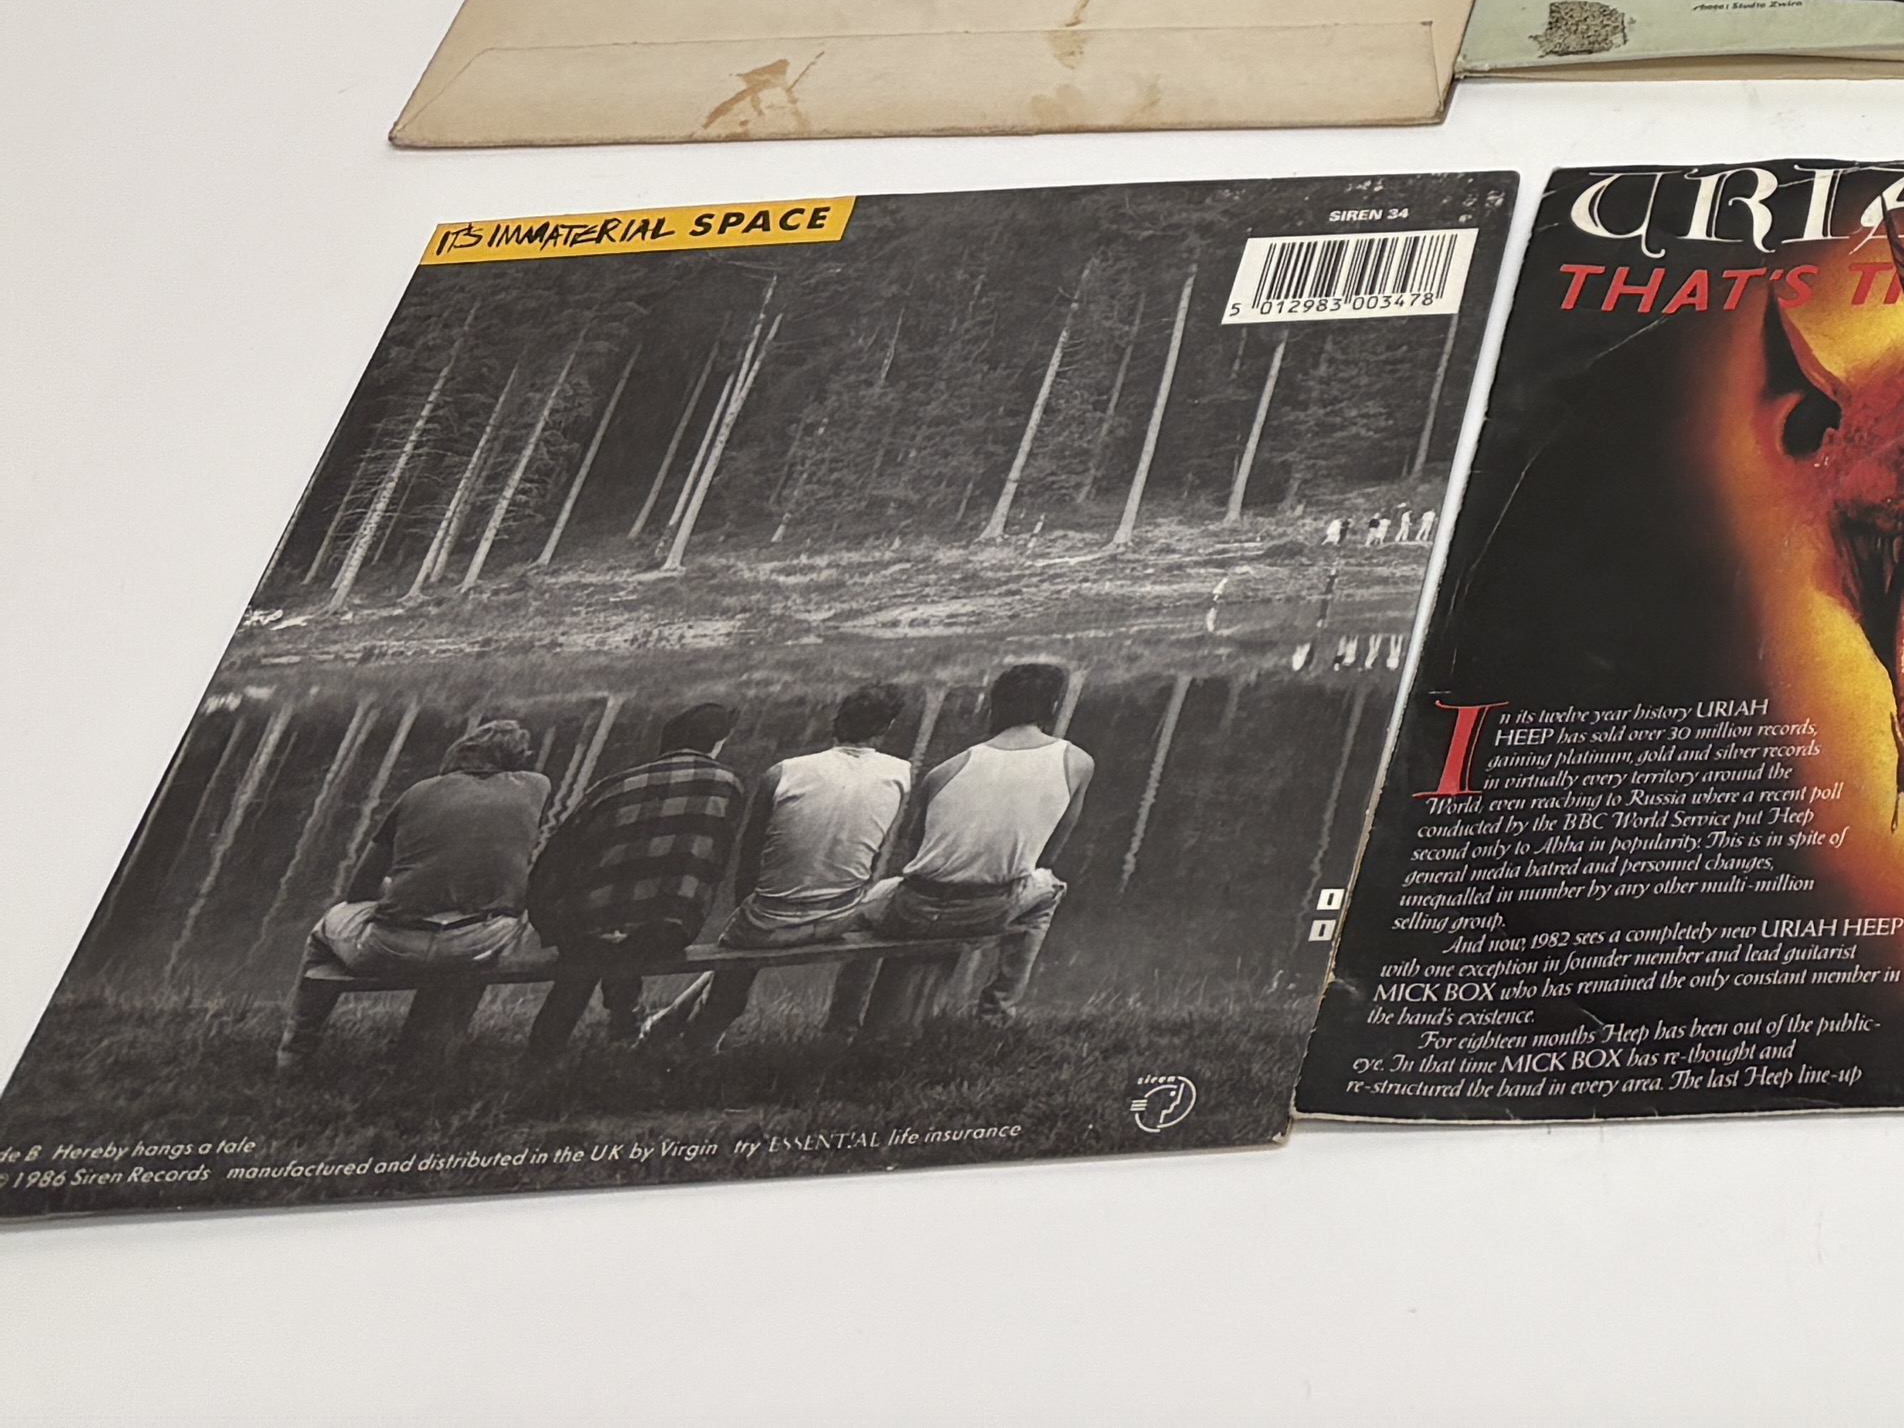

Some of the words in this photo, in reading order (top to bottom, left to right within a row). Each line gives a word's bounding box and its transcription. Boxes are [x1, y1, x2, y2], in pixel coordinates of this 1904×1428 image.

[487, 214, 675, 253] IMMATERIAL
[687, 205, 832, 238] SPACE
[1328, 208, 1383, 223] SIREN
[1386, 207, 1410, 221] 34
[1558, 262, 1820, 315] THAT'S
[1228, 302, 1242, 318] 5
[1260, 297, 1343, 316] 012983
[1352, 292, 1436, 311] 003478
[1515, 708, 1536, 725] its
[1538, 706, 1591, 725] twelve
[1593, 708, 1632, 726] year
[1633, 704, 1694, 725] history
[1695, 698, 1770, 720] URIAH
[1494, 727, 1555, 748] HEEP
[1556, 727, 1588, 745] has
[1589, 724, 1626, 744] sold
[1628, 726, 1667, 742] over
[1667, 726, 1693, 742] 30
[1694, 721, 1755, 741] million
[1757, 718, 1820, 738] records,
[1484, 752, 1551, 774] gaining
[1553, 748, 1634, 772] platinum,
[1635, 744, 1676, 768] gold
[1677, 744, 1713, 762] and
[1714, 742, 1762, 761] silver
[1763, 739, 1822, 759] records
[1760, 917, 1838, 940] URIAH
[1373, 981, 1441, 1004] MICK
[1443, 981, 1498, 1003] BOX
[12, 1170, 68, 1189] 1986
[70, 1167, 123, 1187] Siren
[126, 1164, 212, 1185] Records
[226, 1156, 373, 1181] manufactured
[374, 1154, 417, 1175] and
[417, 1147, 529, 1173] distributed
[529, 1147, 549, 1165] in
[553, 1146, 585, 1164] the
[590, 1143, 624, 1162] UK
[629, 1142, 655, 1163] by
[659, 1138, 718, 1162] Virgin
[733, 1138, 762, 1159] try
[887, 1127, 921, 1147] life
[924, 1122, 1023, 1144] insurance
[51, 1142, 130, 1162] Hereby
[131, 1139, 194, 1161] hangs
[198, 1142, 213, 1156] a
[216, 1136, 257, 1155] tale
